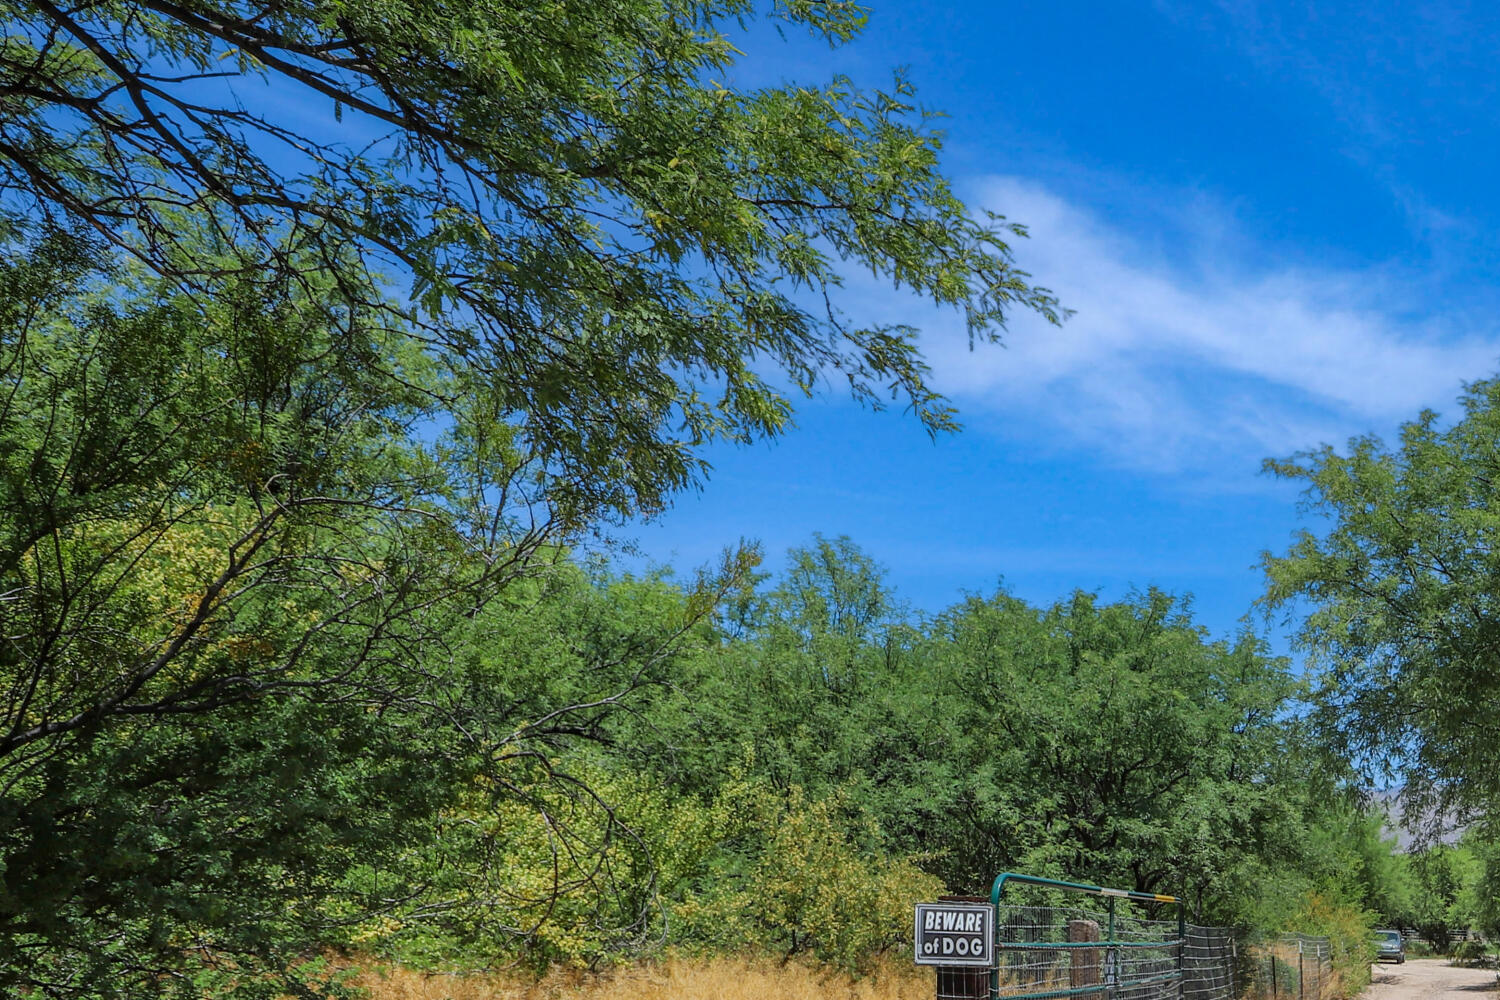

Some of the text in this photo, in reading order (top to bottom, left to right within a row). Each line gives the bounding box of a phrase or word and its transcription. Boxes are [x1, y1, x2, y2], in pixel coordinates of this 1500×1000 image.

[925, 911, 982, 931] BEWARE
[924, 937, 983, 955] of DOG
